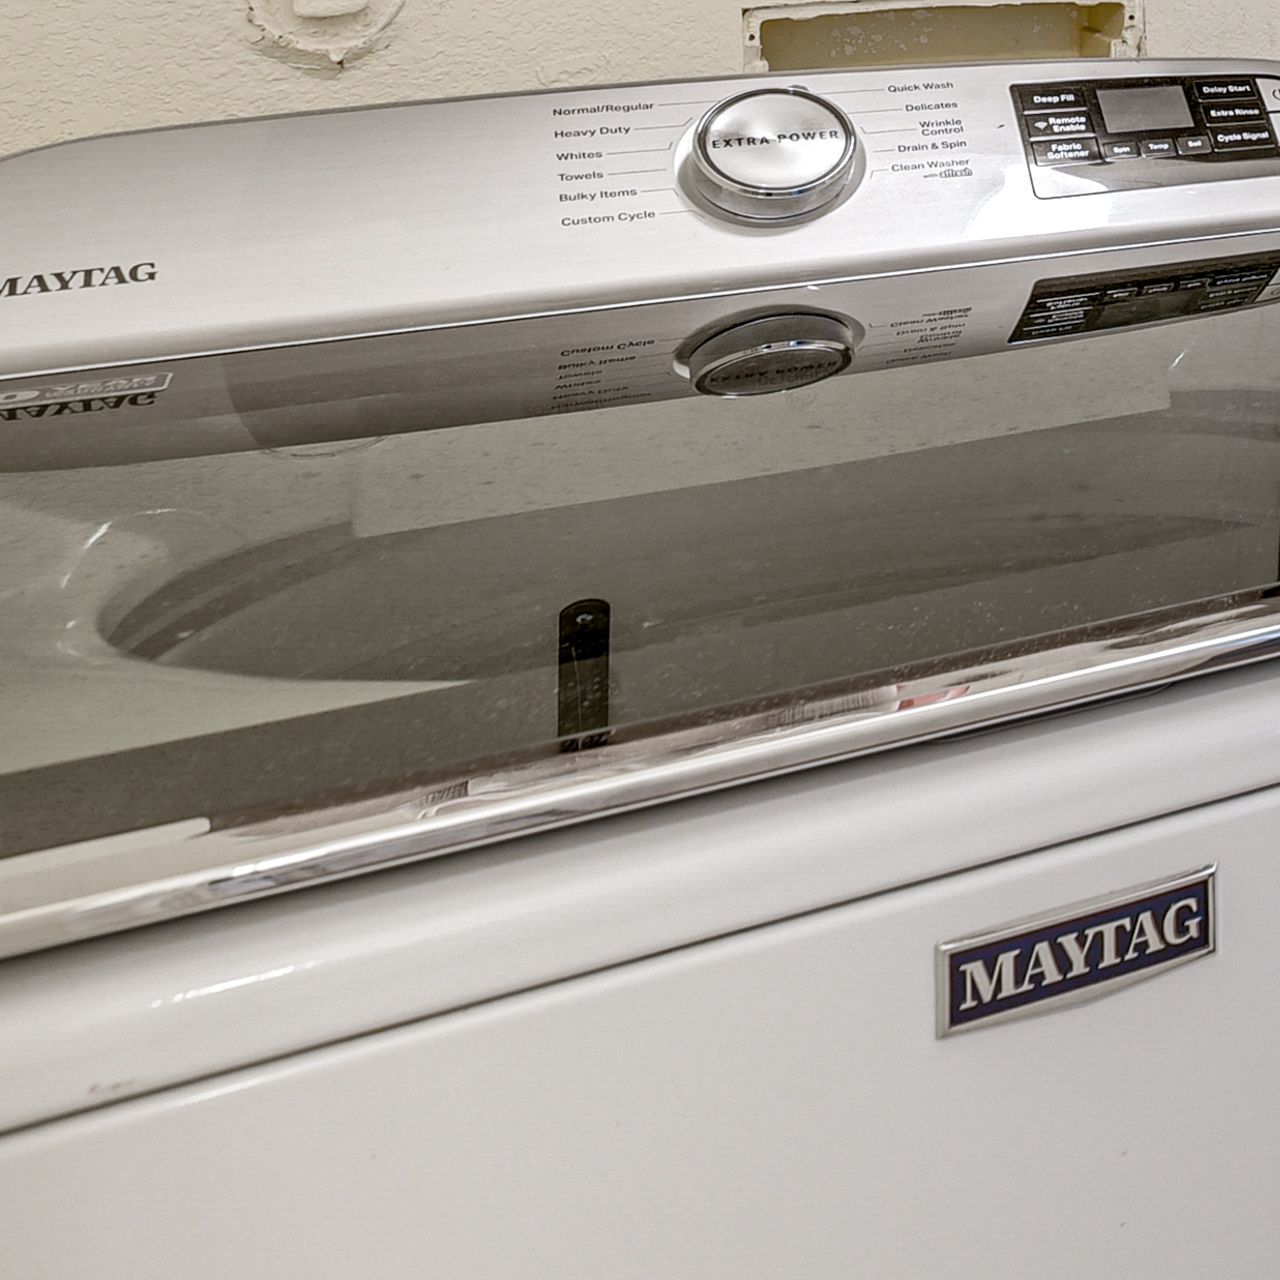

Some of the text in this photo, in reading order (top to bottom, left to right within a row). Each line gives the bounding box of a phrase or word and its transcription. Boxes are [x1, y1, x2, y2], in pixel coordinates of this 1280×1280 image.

[887, 82, 954, 93] Quick Wash
[1203, 84, 1251, 94] Delay Start
[1033, 94, 1075, 103] Deep Fill
[553, 103, 654, 116] Normal/Regular
[905, 102, 958, 112] Delicates
[1210, 108, 1260, 117] Extra Rinse
[919, 119, 962, 128] Wrinkle
[1049, 116, 1086, 125] Remote
[554, 126, 631, 138] Heavy Duty
[921, 126, 964, 136] Control
[1053, 124, 1086, 132] Enable
[712, 130, 839, 149] EXTRA POWER
[1217, 131, 1269, 142] Cycle Signal
[897, 143, 929, 152] Drain
[941, 140, 967, 149] Spin
[1051, 143, 1082, 151] Fabric
[1149, 143, 1169, 151] Temp
[556, 151, 603, 161] Whites
[1047, 150, 1089, 160] Softener
[891, 159, 970, 172] Clean Washer
[558, 171, 604, 181] Towels
[559, 188, 637, 202] Bulky Items
[561, 211, 655, 226] Custom Cycle
[958, 897, 1202, 1011] MAYTAG
